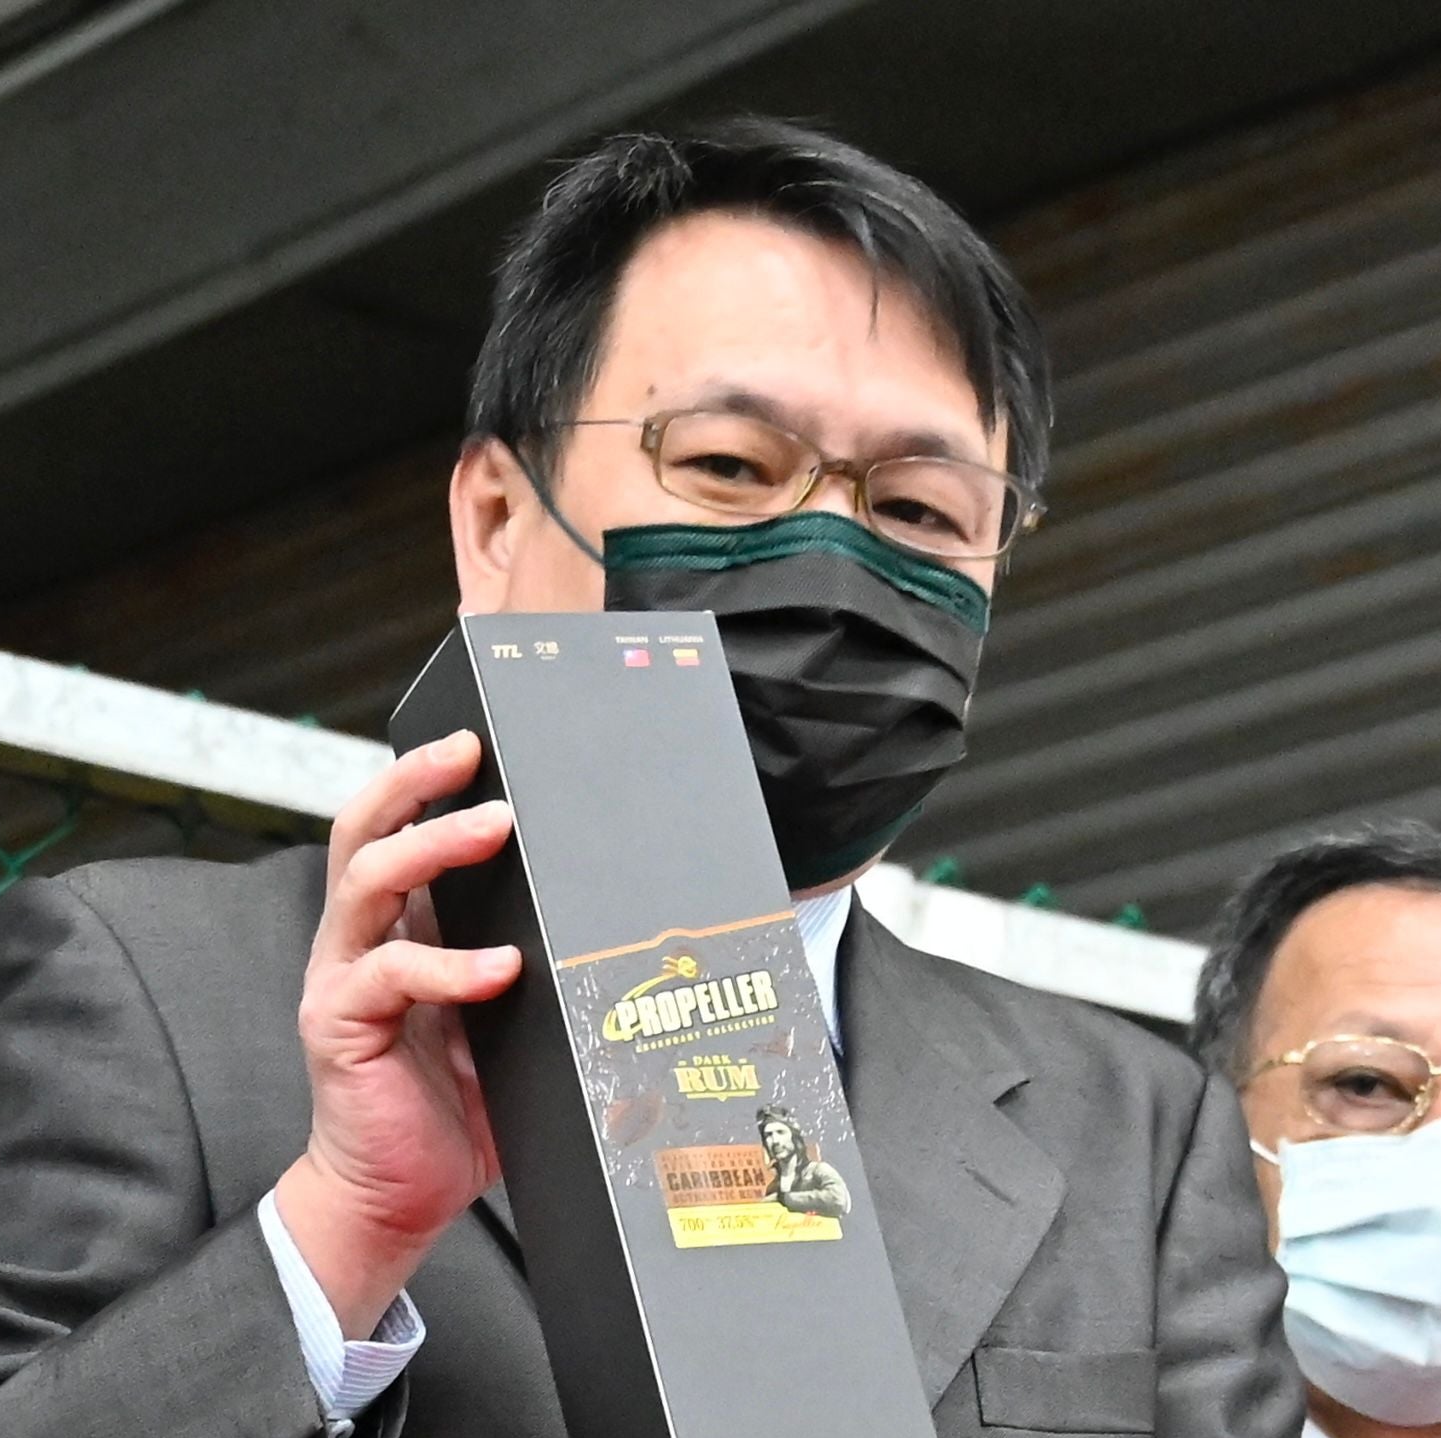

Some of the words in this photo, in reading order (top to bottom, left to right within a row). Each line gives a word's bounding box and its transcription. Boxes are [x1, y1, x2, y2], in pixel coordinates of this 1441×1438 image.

[615, 970, 779, 1043] PROPELLER
[692, 1055, 732, 1066] DARK
[674, 1065, 762, 1093] RUM
[666, 1167, 766, 1191] CARIBBEAN
